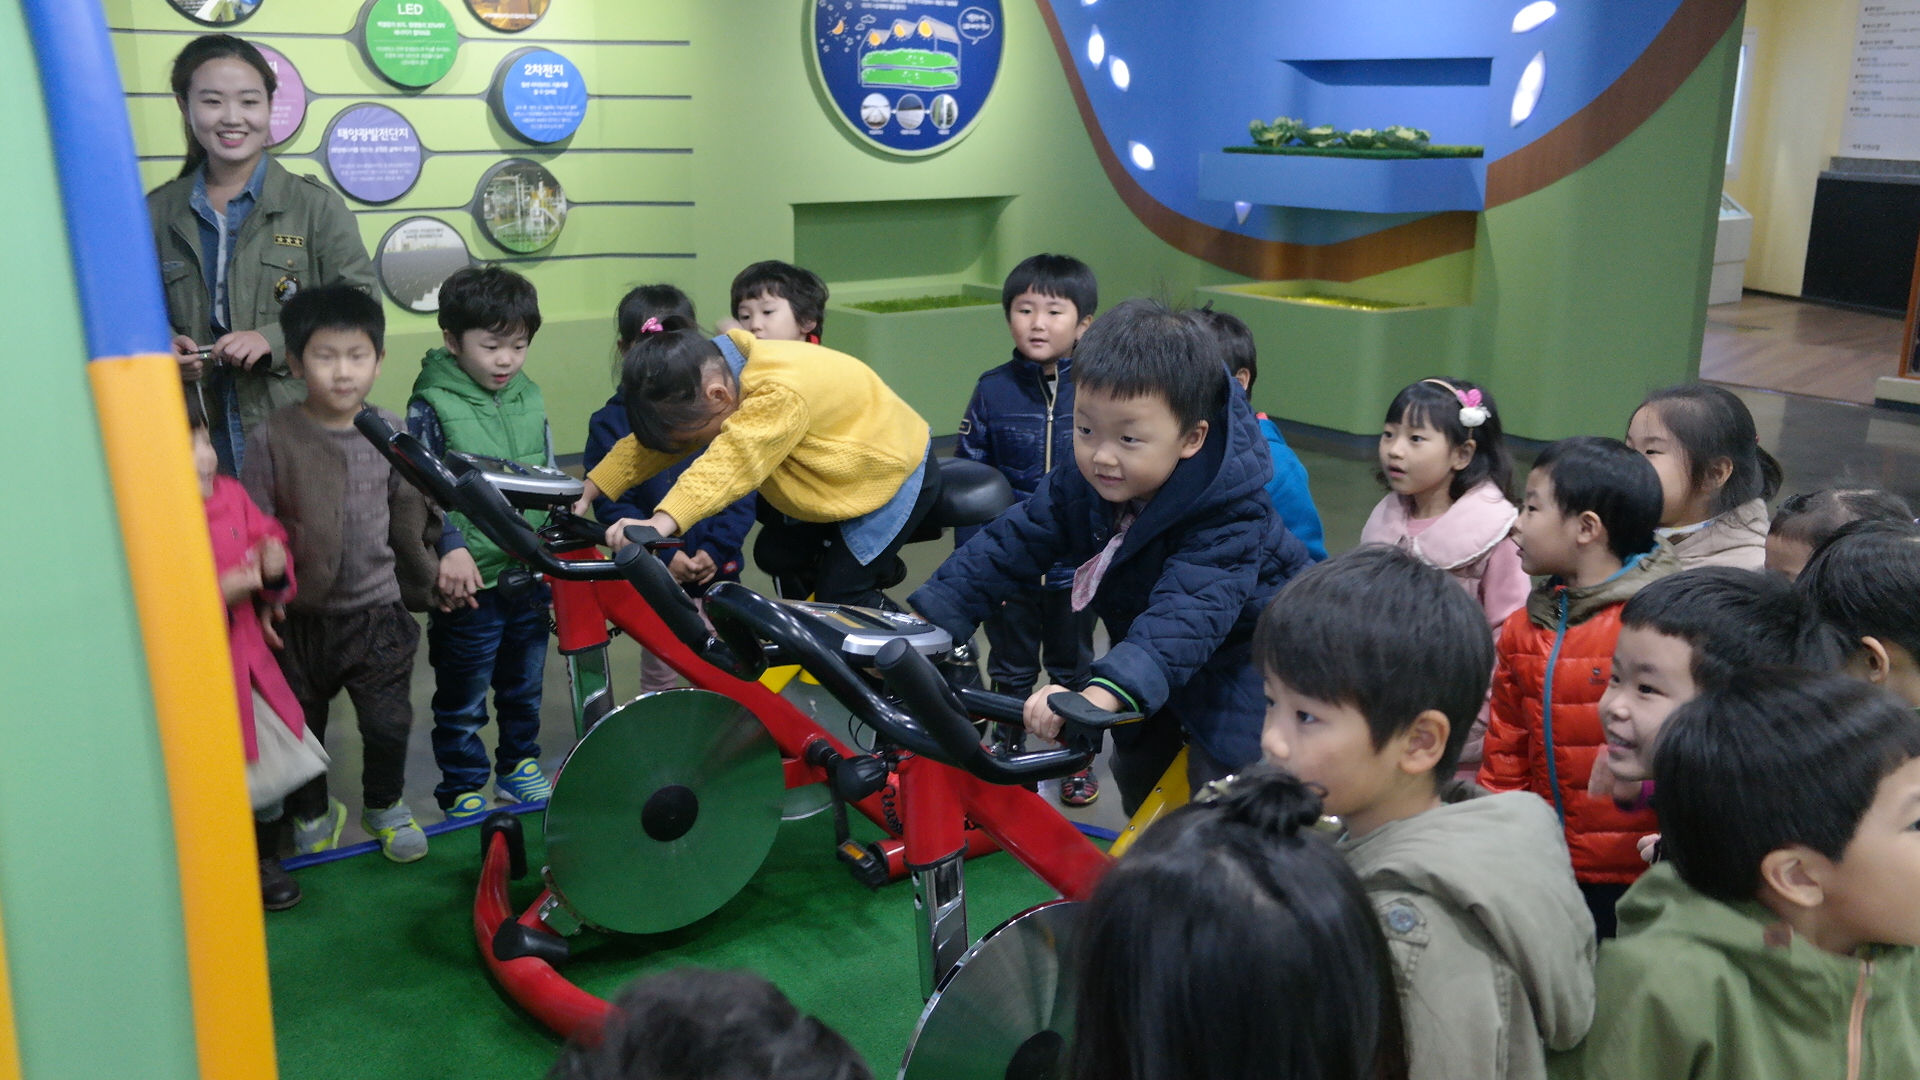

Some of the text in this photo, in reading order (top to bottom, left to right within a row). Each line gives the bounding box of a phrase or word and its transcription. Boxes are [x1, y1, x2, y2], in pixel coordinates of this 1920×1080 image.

[397, 3, 424, 15] LED
[524, 63, 564, 78] 2차전지
[337, 127, 409, 142] 태양광발전단지
